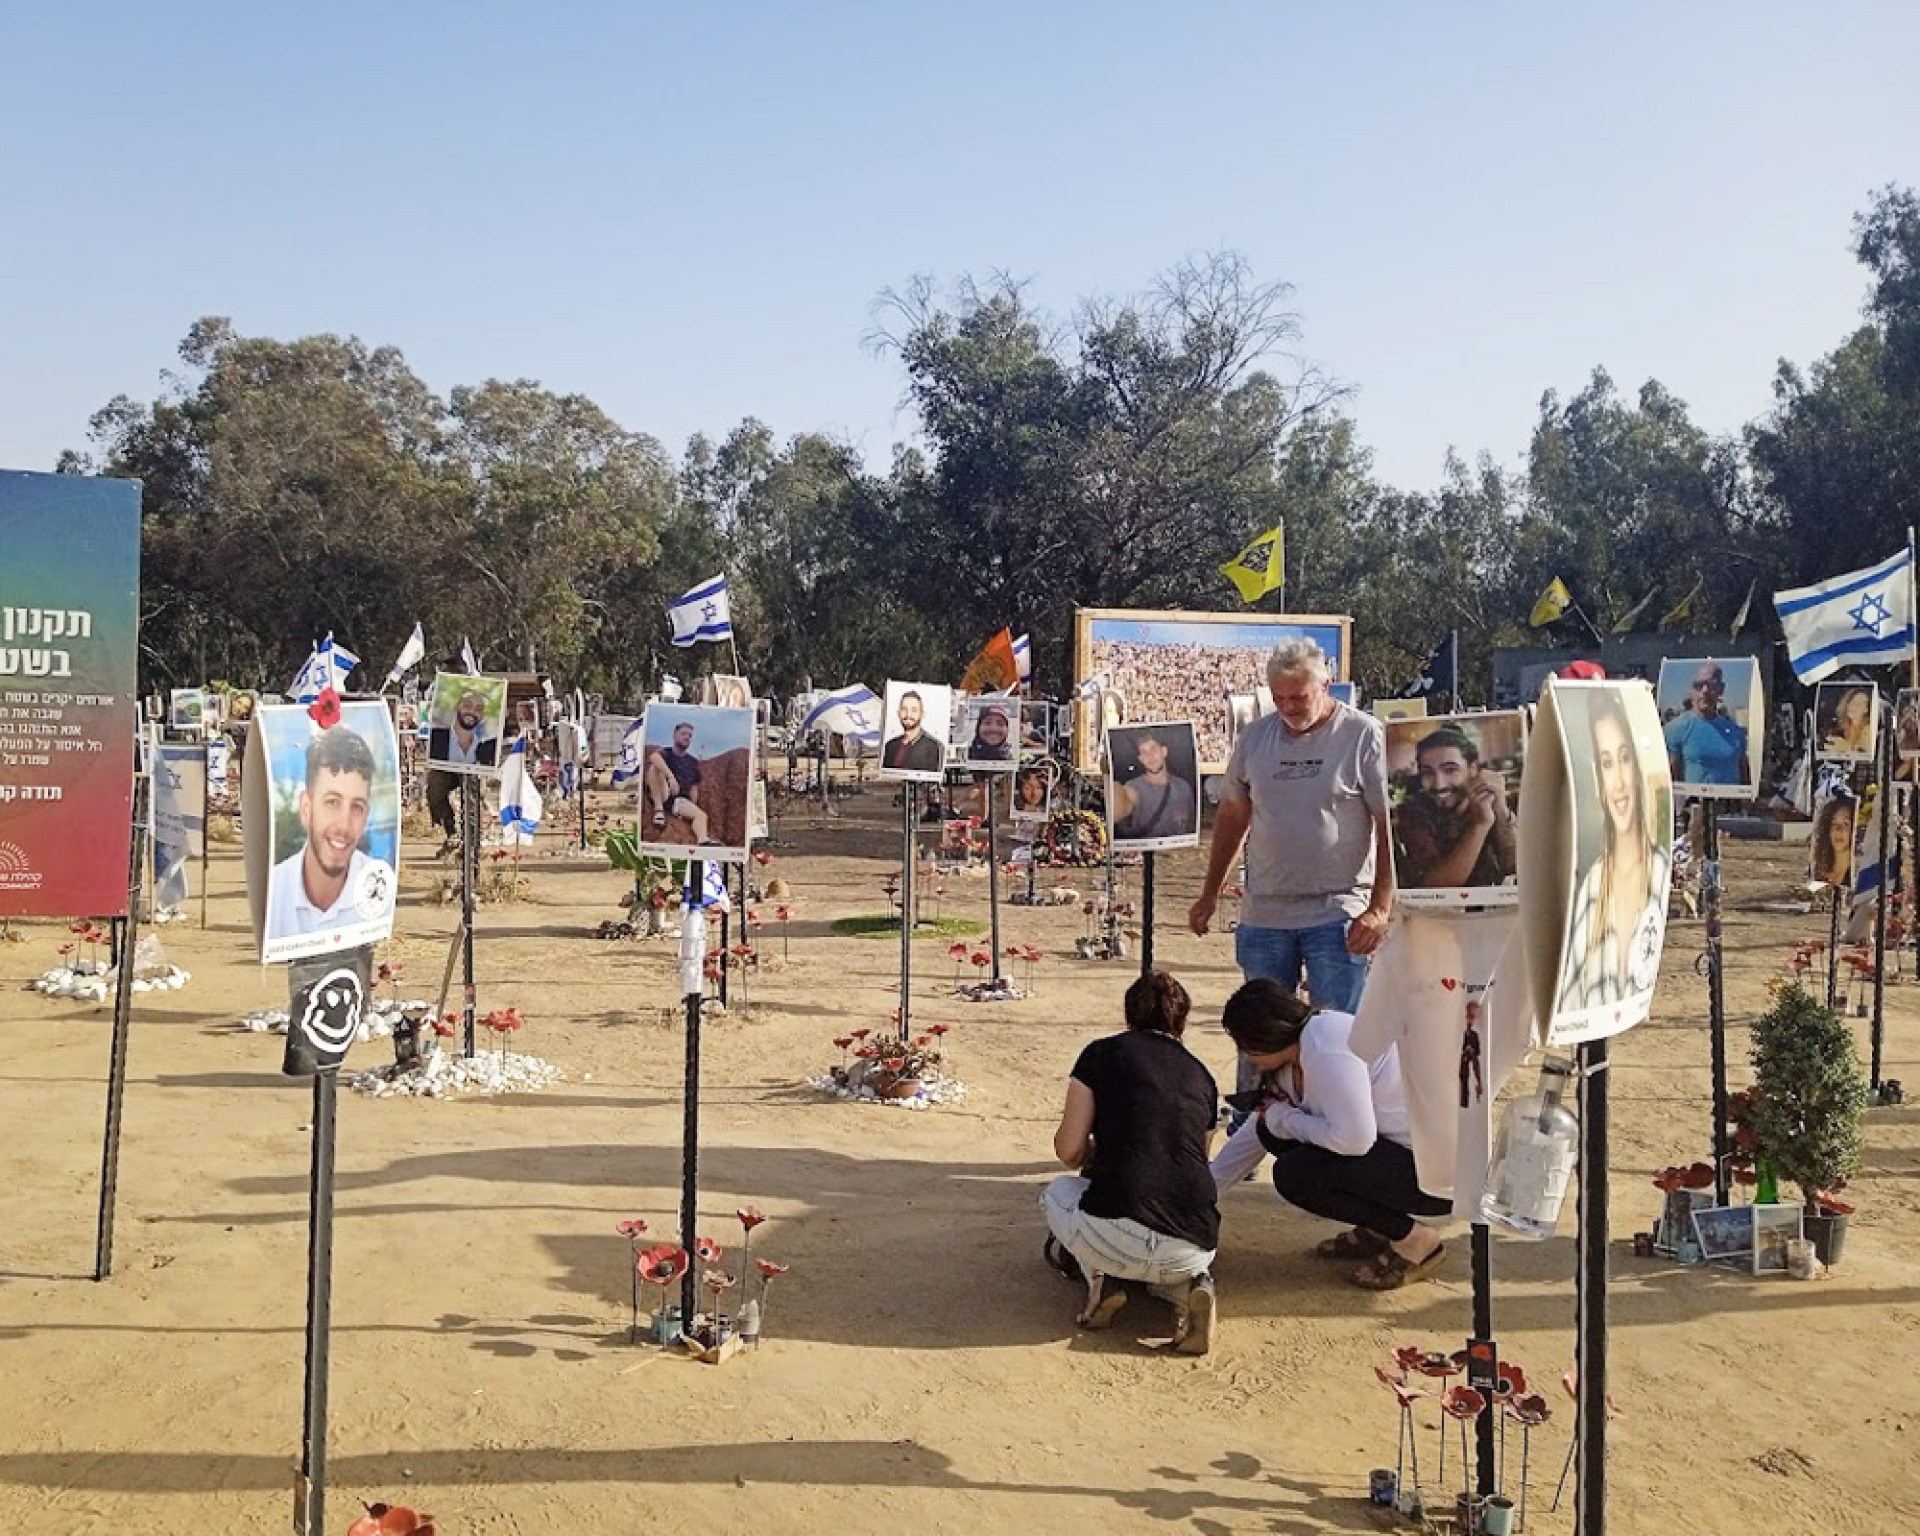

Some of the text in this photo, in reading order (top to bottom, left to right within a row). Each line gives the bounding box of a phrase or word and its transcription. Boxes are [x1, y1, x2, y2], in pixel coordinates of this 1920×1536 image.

[4, 606, 91, 642] תקנון
[42, 692, 73, 707] יקרים
[12, 708, 30, 718] את
[18, 723, 57, 735] התנהגו
[61, 725, 82, 736] אנא
[35, 738, 50, 750] על
[54, 740, 85, 751] איסור
[3, 752, 49, 765] שמרו על
[21, 785, 62, 799] תודה
